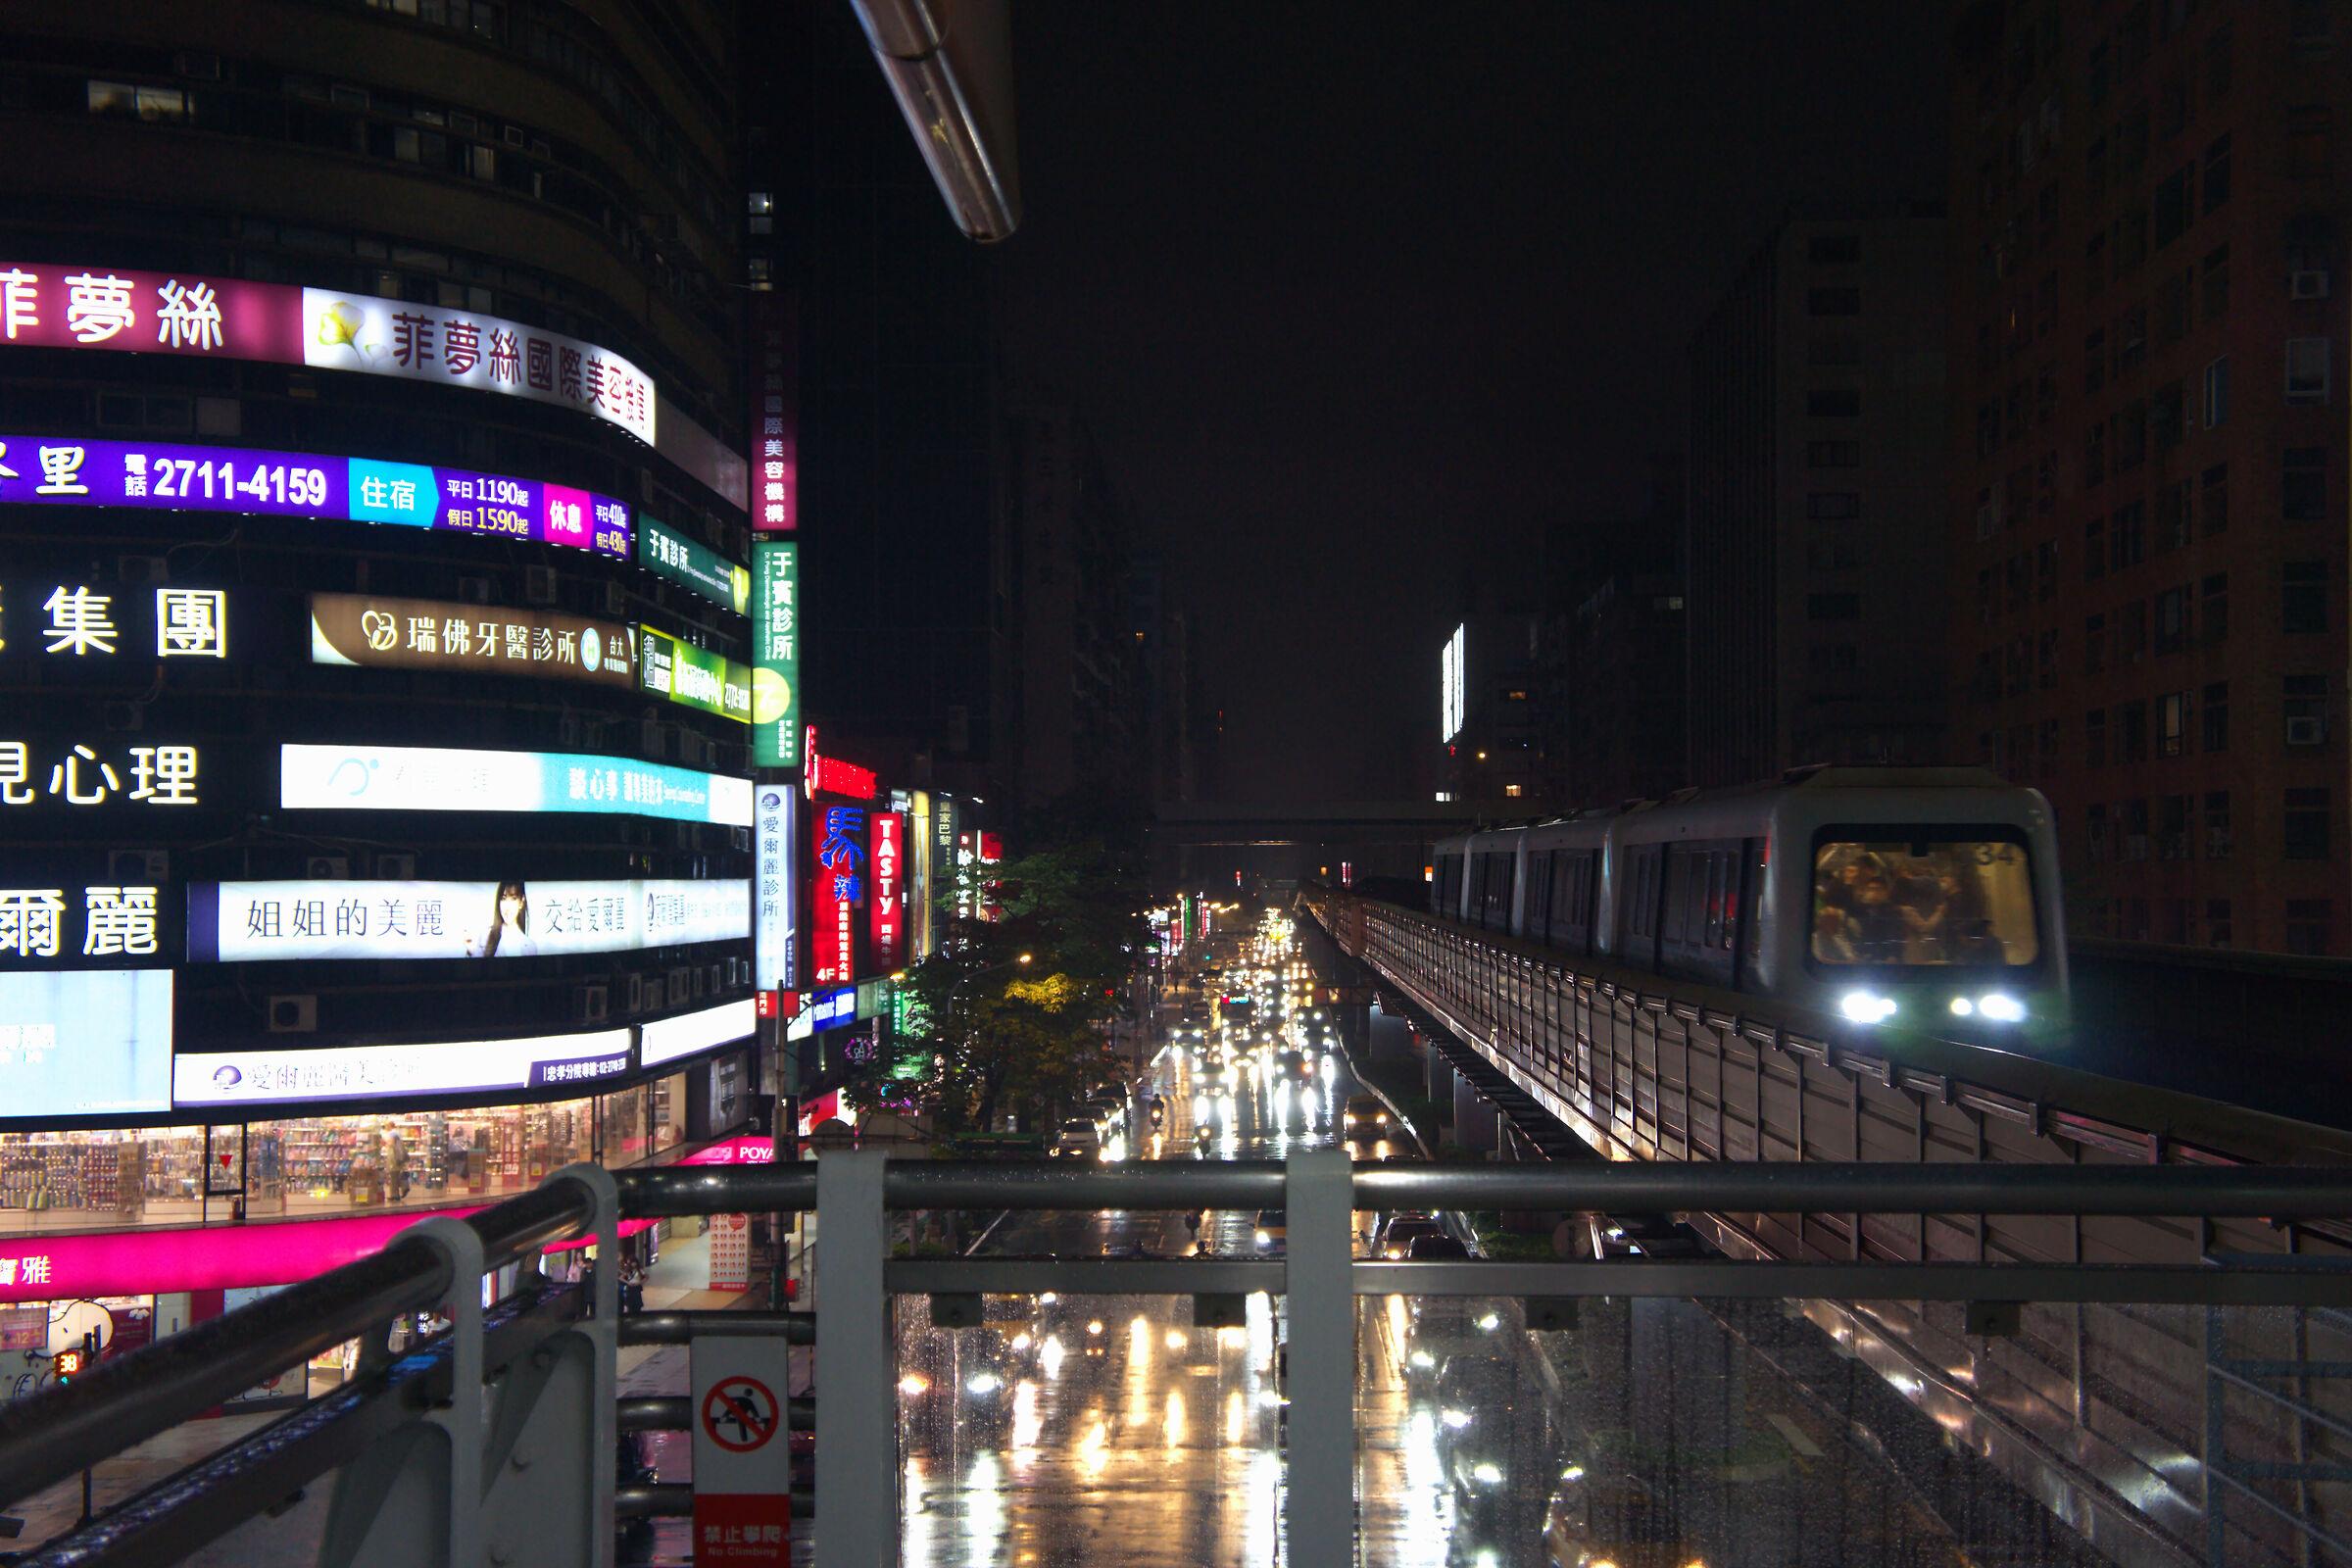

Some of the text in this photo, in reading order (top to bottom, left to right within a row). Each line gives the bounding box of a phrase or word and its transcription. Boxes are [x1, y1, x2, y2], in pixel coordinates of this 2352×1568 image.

[153, 458, 326, 507] 2711-4159
[361, 476, 416, 511] 住宿
[550, 500, 582, 533] 休息
[0, 586, 225, 658] 集團
[407, 616, 575, 665] 瑞佛牙醫診所
[762, 816, 780, 917] 愛爾麗診所
[247, 899, 444, 939] 姐姐的美麗
[815, 968, 836, 981] 4F
[60, 1354, 78, 1372] 38
[708, 1545, 777, 1559] No Climbing
